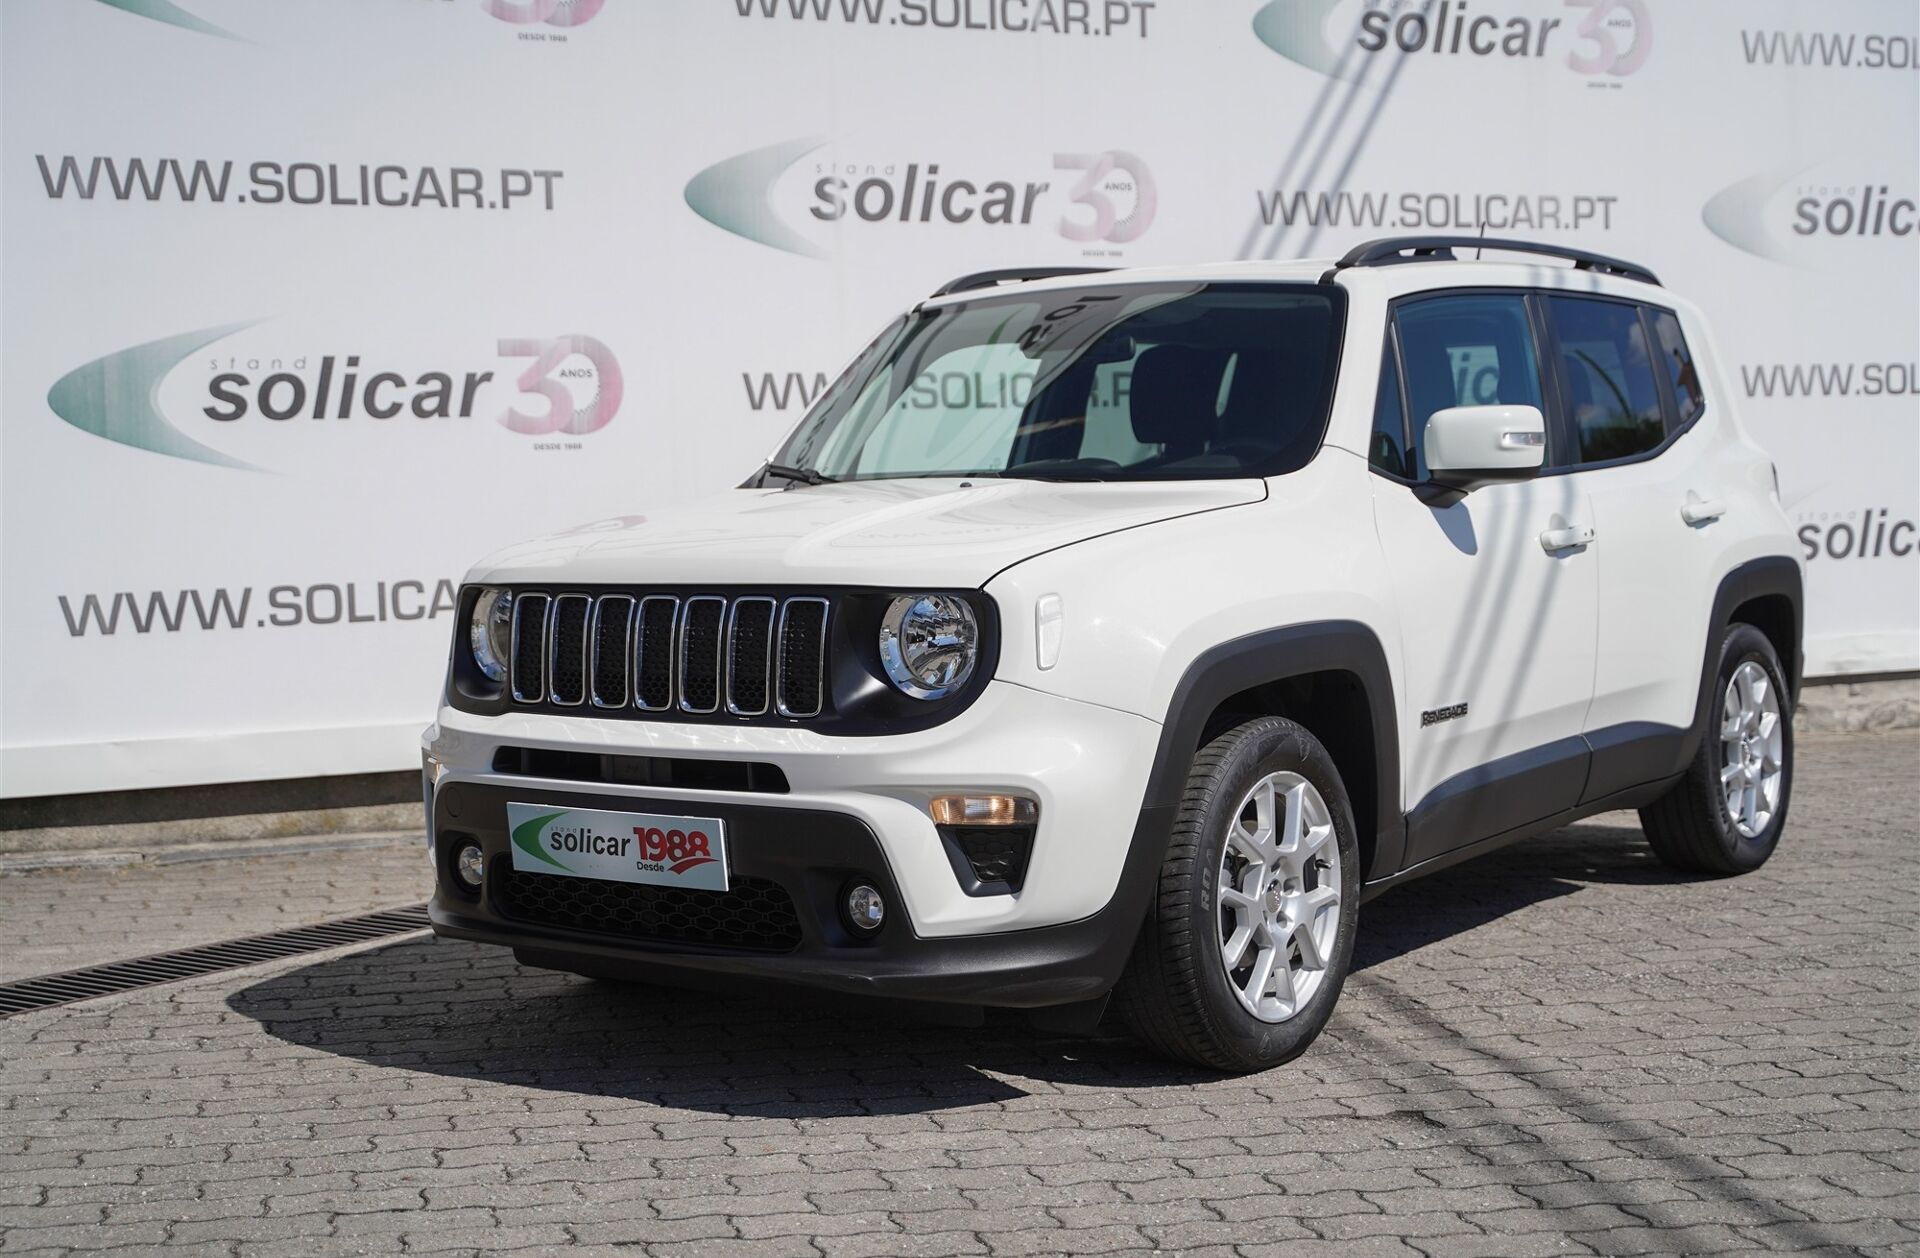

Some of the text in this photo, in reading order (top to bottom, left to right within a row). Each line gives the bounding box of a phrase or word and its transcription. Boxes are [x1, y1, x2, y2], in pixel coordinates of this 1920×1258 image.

[1357, 0, 1561, 57] solicar
[35, 154, 564, 210] WWW.SOLICAR.PT
[809, 163, 1051, 225] solicar
[1257, 190, 1618, 230] WWW.SOLICAR.PT
[1792, 185, 1919, 236] solic
[202, 355, 494, 421] solicar
[559, 368, 593, 378] ANOS
[1797, 508, 1919, 560] solic
[1421, 702, 1468, 728] RENEGADE
[550, 827, 711, 862] solicar 1988
[636, 861, 665, 872] Desde
